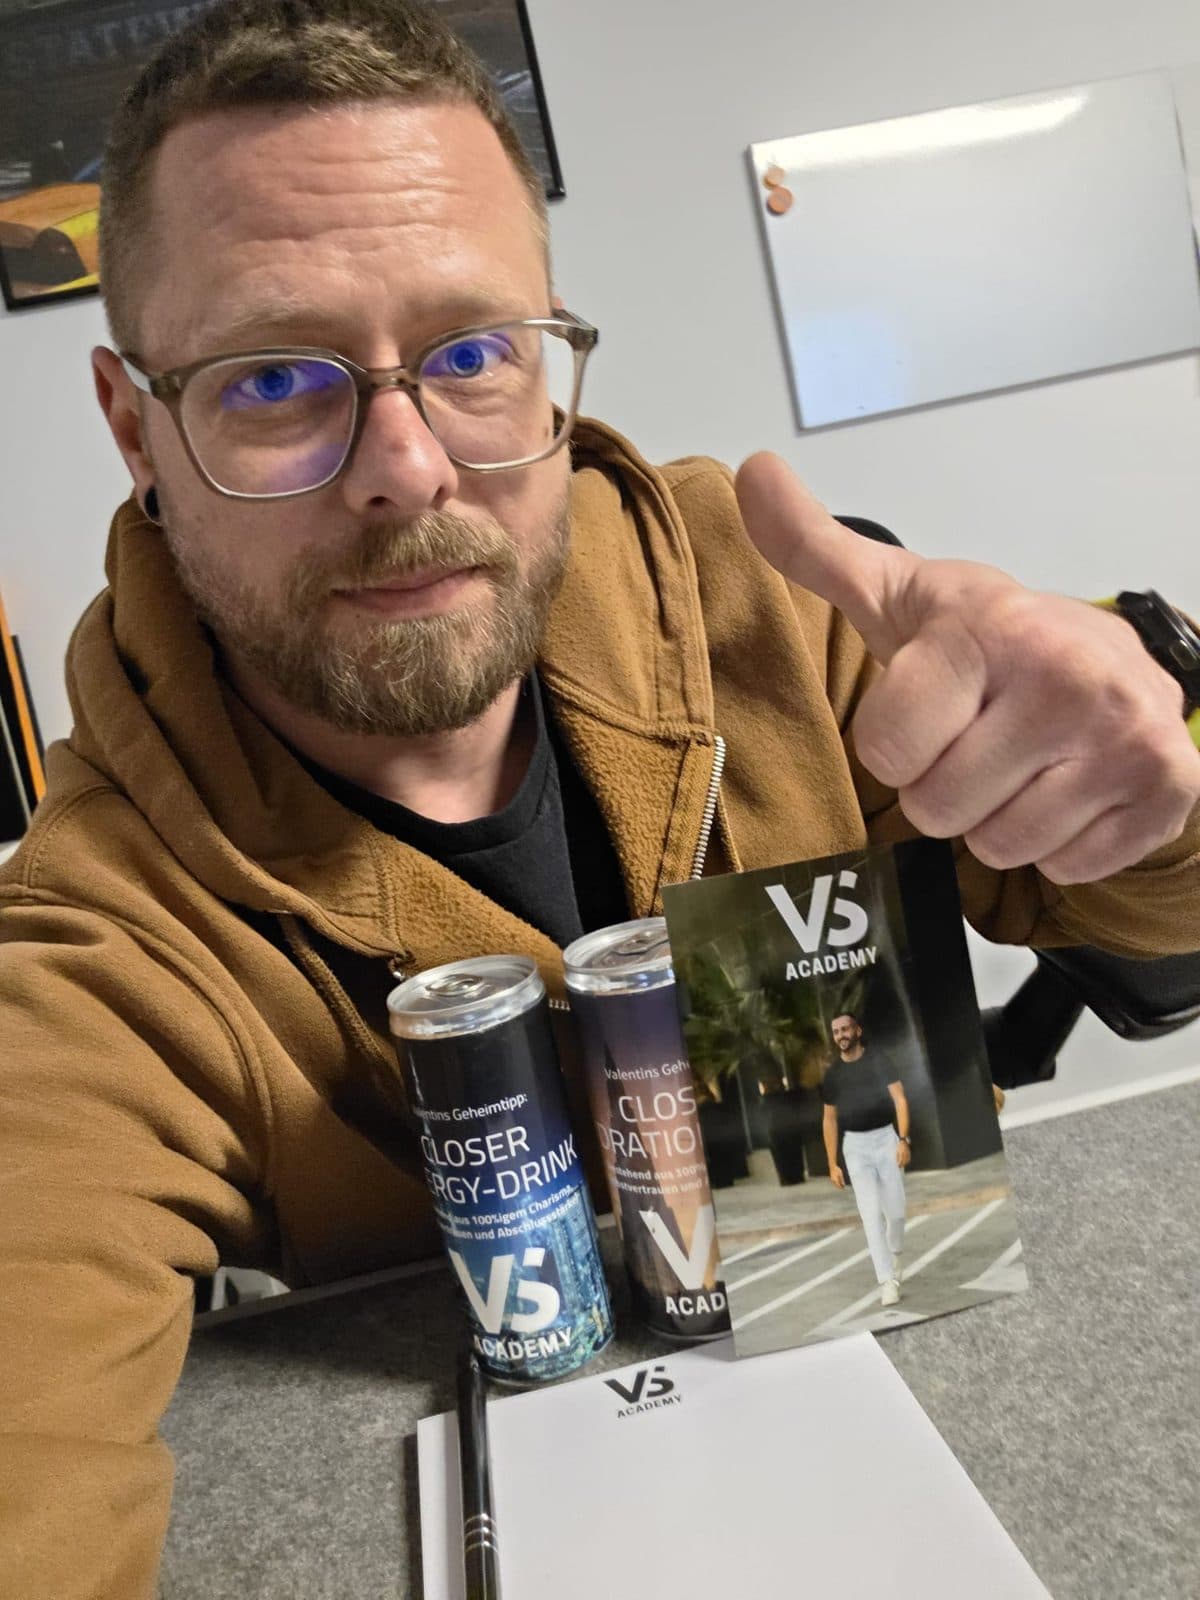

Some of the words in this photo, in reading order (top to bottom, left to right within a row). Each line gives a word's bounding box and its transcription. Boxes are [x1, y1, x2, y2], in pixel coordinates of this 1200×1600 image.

[764, 869, 869, 954] VS
[785, 945, 877, 982] ACADEMY
[603, 1066, 660, 1081] Valentins
[661, 1059, 691, 1076] Geh
[452, 1093, 529, 1121] Geheimtipp:
[420, 1125, 531, 1168] CLOSER
[473, 1326, 573, 1361] ACADEMY
[616, 1395, 683, 1419] ACADEMY
